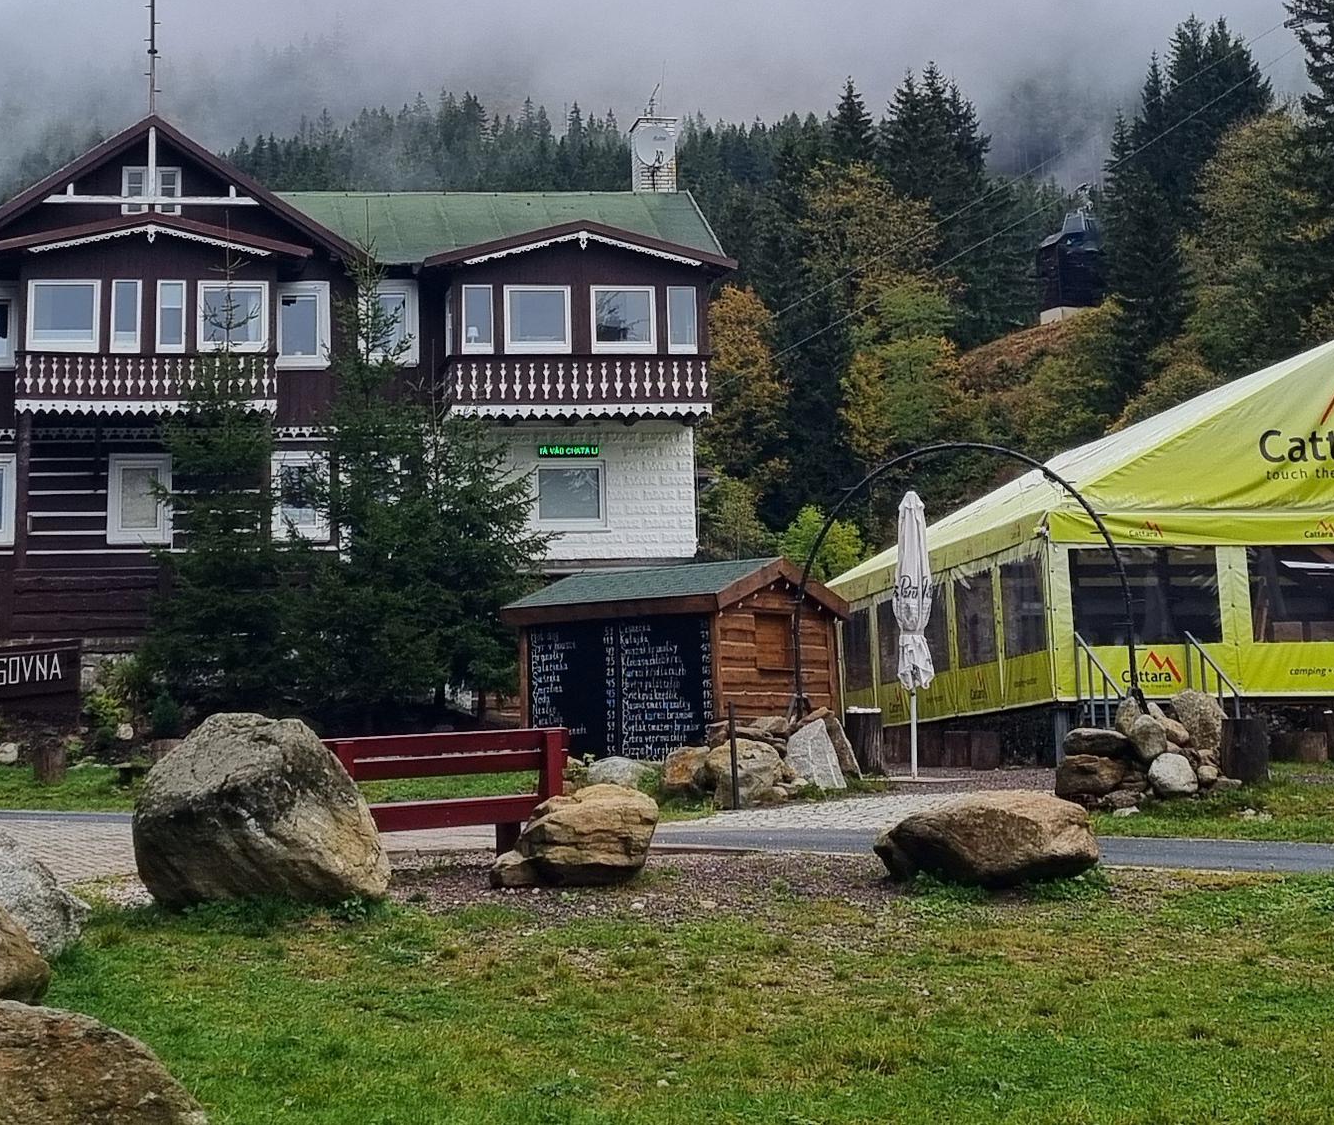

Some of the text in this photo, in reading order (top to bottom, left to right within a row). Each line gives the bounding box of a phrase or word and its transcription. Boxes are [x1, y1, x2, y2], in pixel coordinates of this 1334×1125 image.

[1266, 468, 1308, 481] touch
[1304, 530, 1334, 539] Cattara
[1289, 666, 1327, 675] camping
[1121, 670, 1172, 683] Cttara
